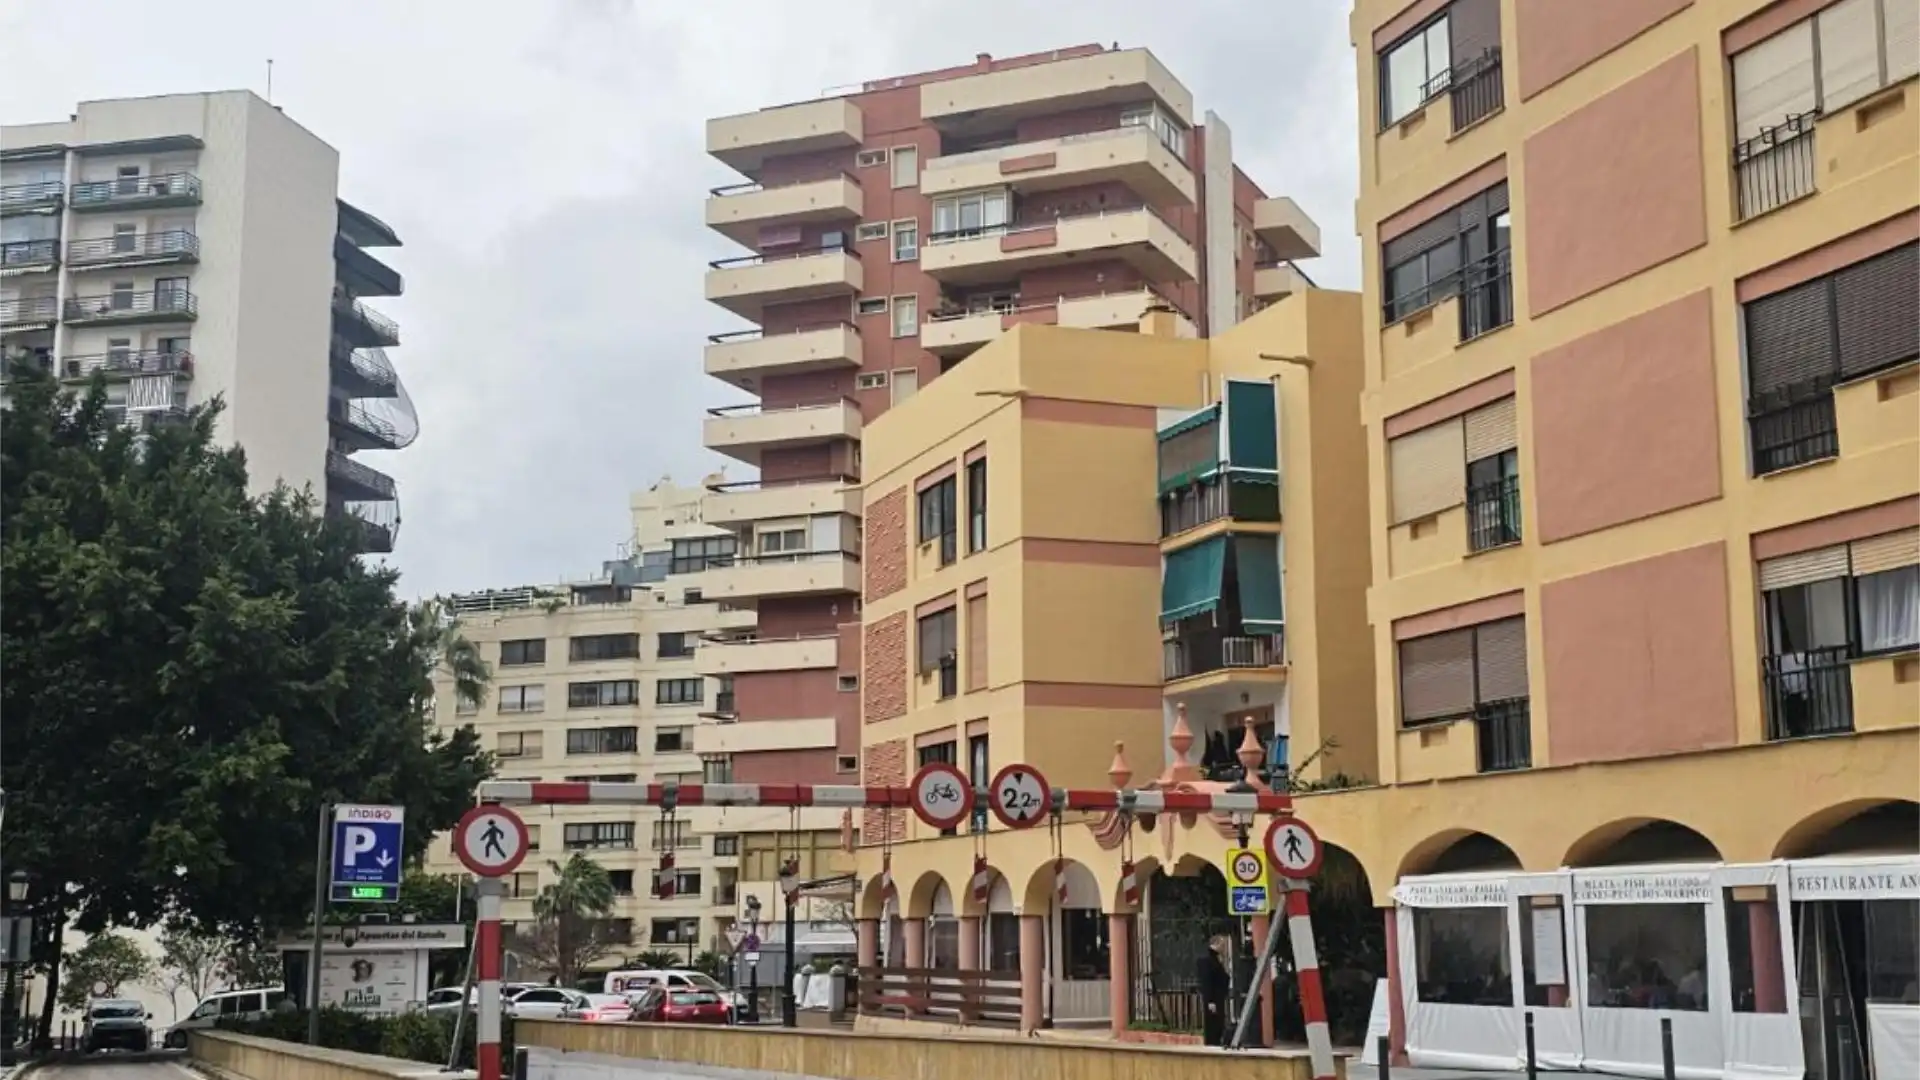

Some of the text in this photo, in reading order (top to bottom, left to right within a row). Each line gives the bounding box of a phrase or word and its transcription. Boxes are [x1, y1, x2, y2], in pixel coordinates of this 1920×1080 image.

[343, 826, 376, 866] P
[1238, 861, 1256, 874] 30
[1797, 873, 1920, 892] RESTAURANTE AN
